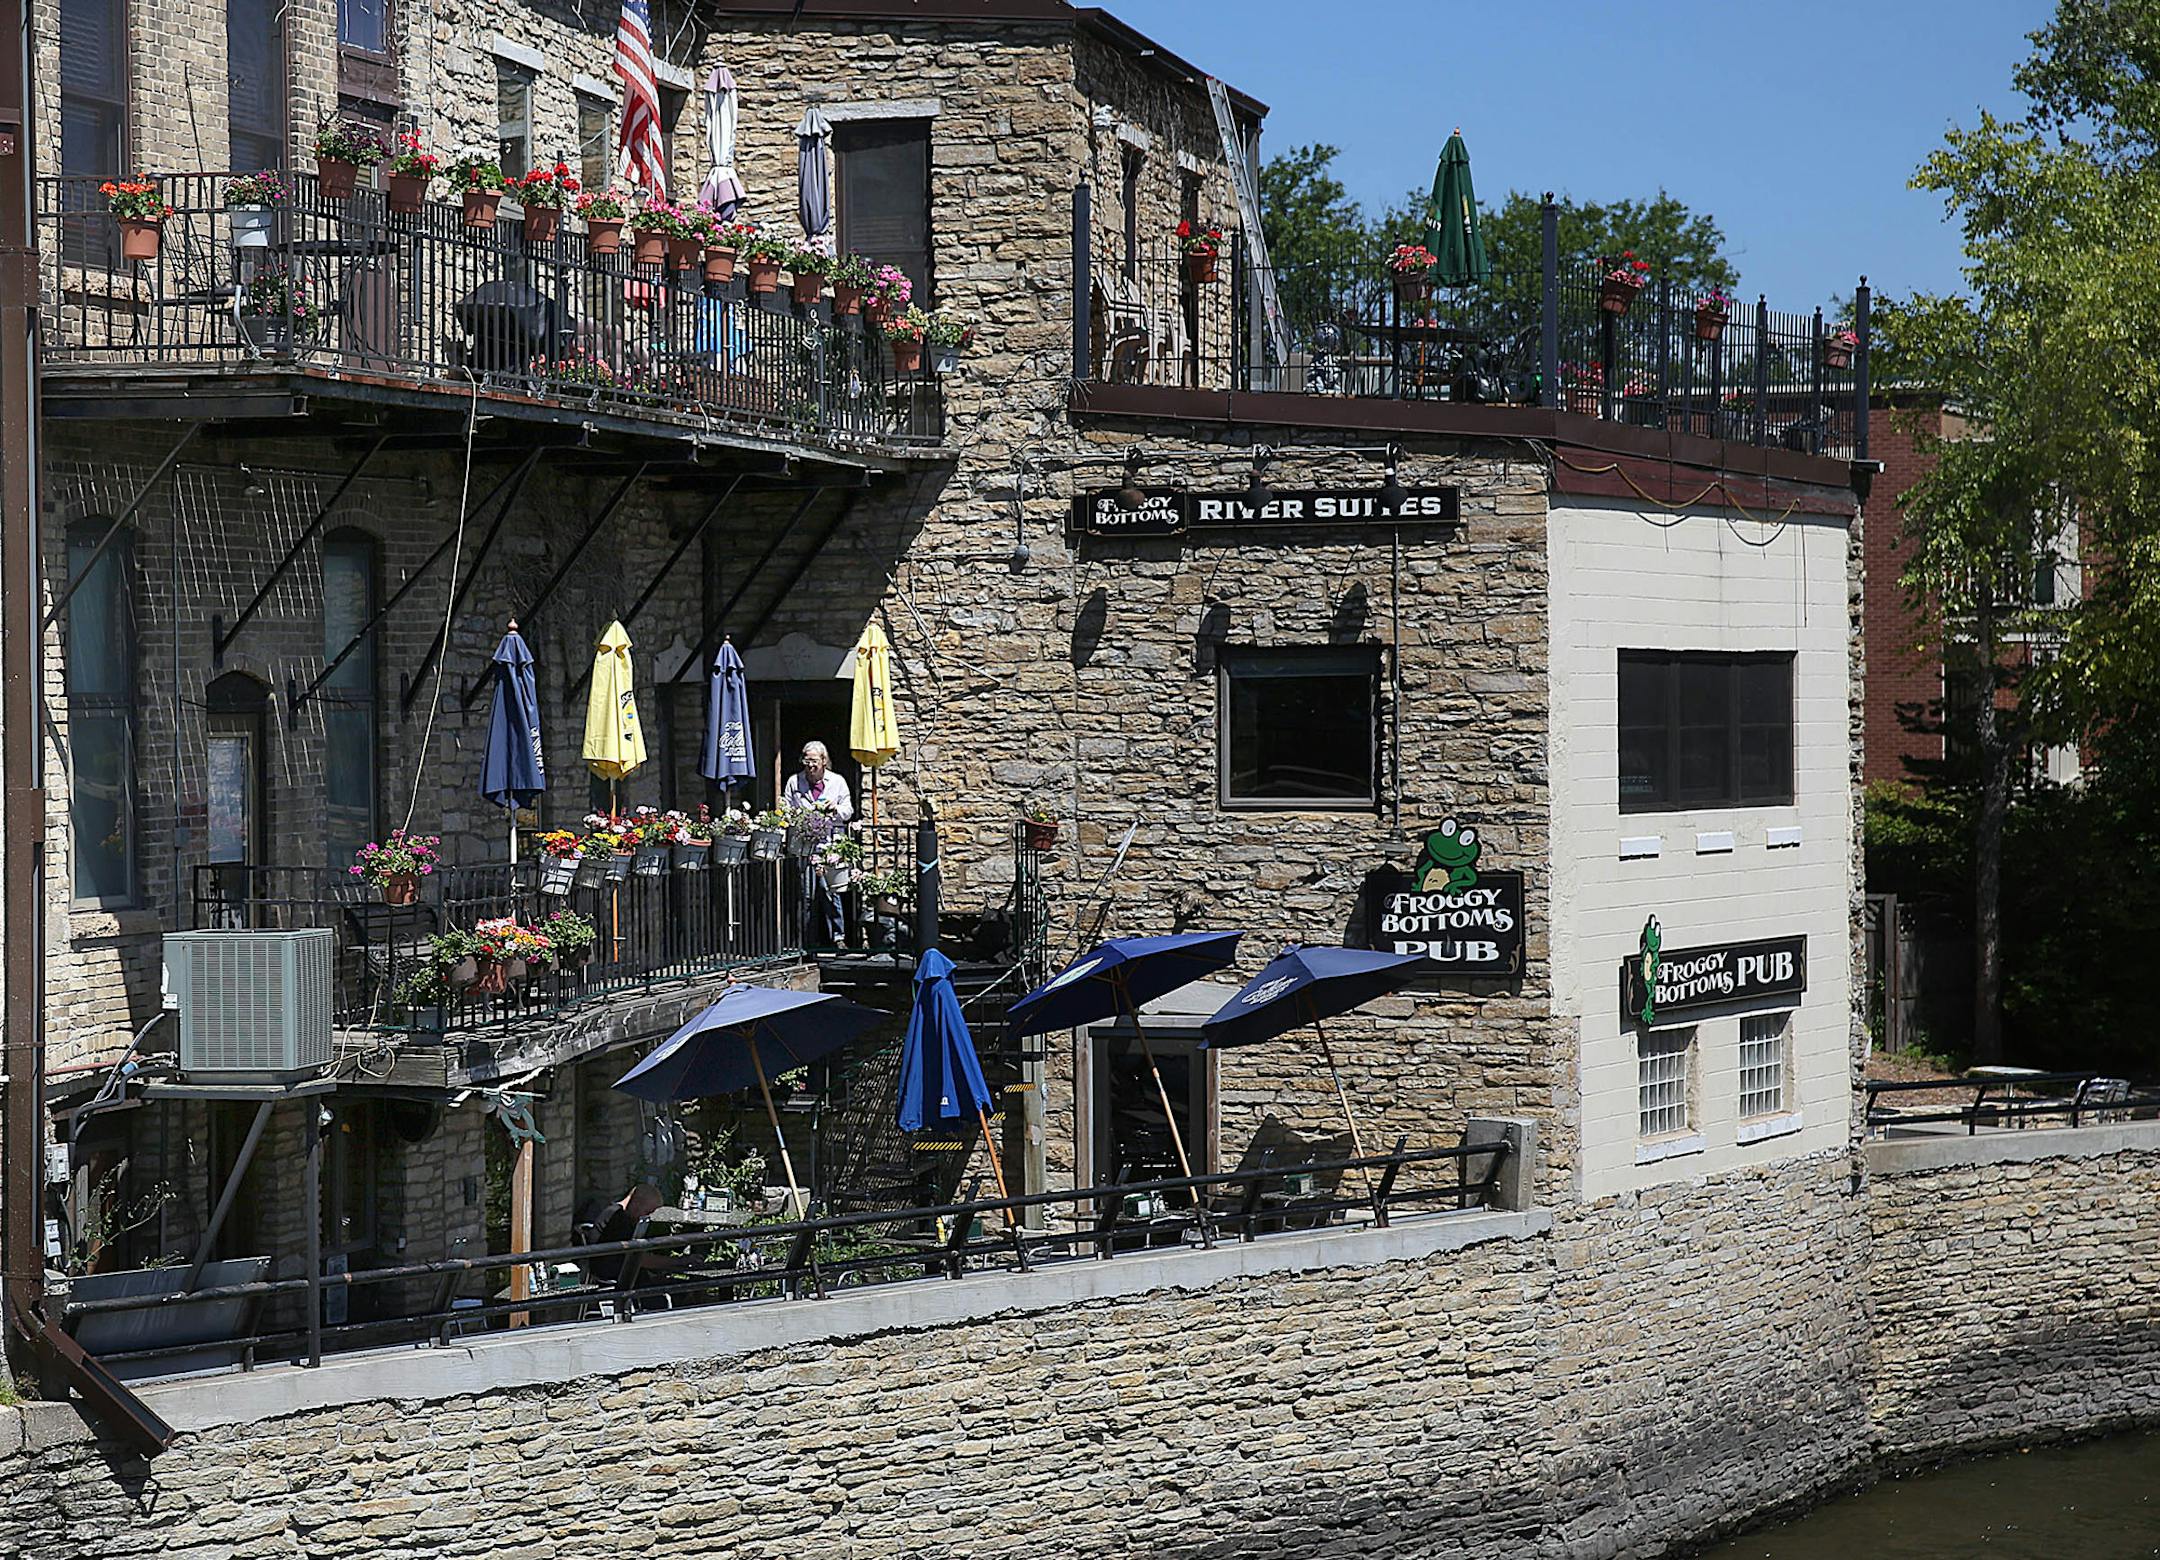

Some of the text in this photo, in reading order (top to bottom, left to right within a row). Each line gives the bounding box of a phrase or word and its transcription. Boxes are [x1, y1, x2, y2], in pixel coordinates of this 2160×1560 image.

[1095, 509, 1179, 524] BOTTOMS
[1199, 499, 1304, 520] RIVER
[1384, 888, 1502, 914] FROGGY
[1381, 908, 1514, 933] BOTTOMS
[1393, 940, 1500, 962] PUB
[1657, 951, 1728, 984] FROGGY
[1737, 951, 1794, 987] PUB
[1654, 970, 1734, 1004] BOTTOMS
